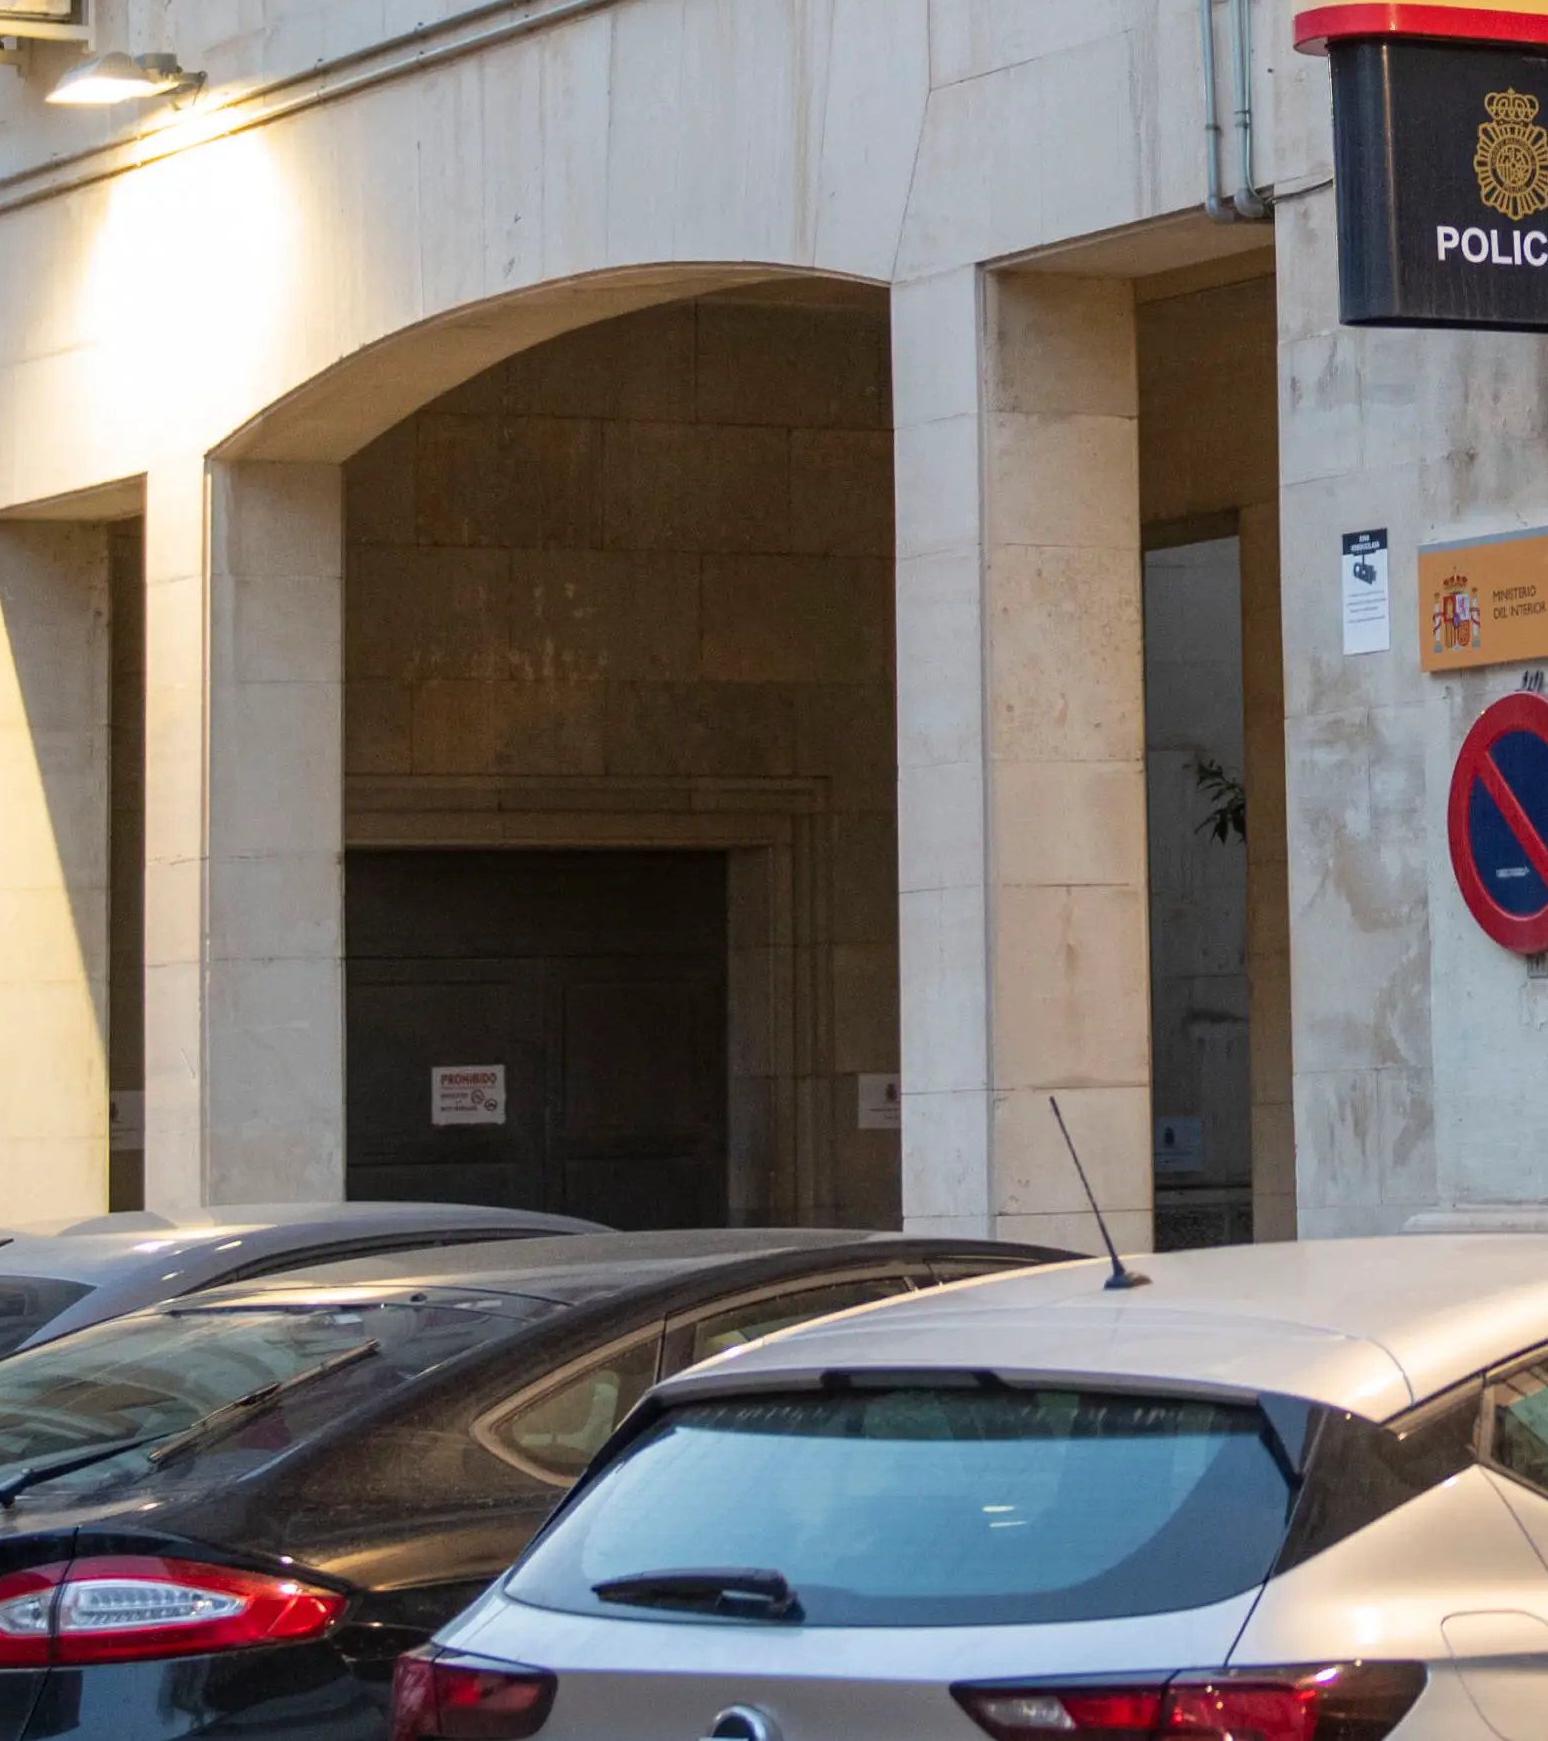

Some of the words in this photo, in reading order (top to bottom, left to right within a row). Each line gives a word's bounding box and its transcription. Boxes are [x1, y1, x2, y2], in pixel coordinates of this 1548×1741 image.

[1492, 585, 1537, 602] MINISTERIO
[1493, 605, 1508, 619] DEL
[440, 1072, 497, 1086] PROHIBIDO
